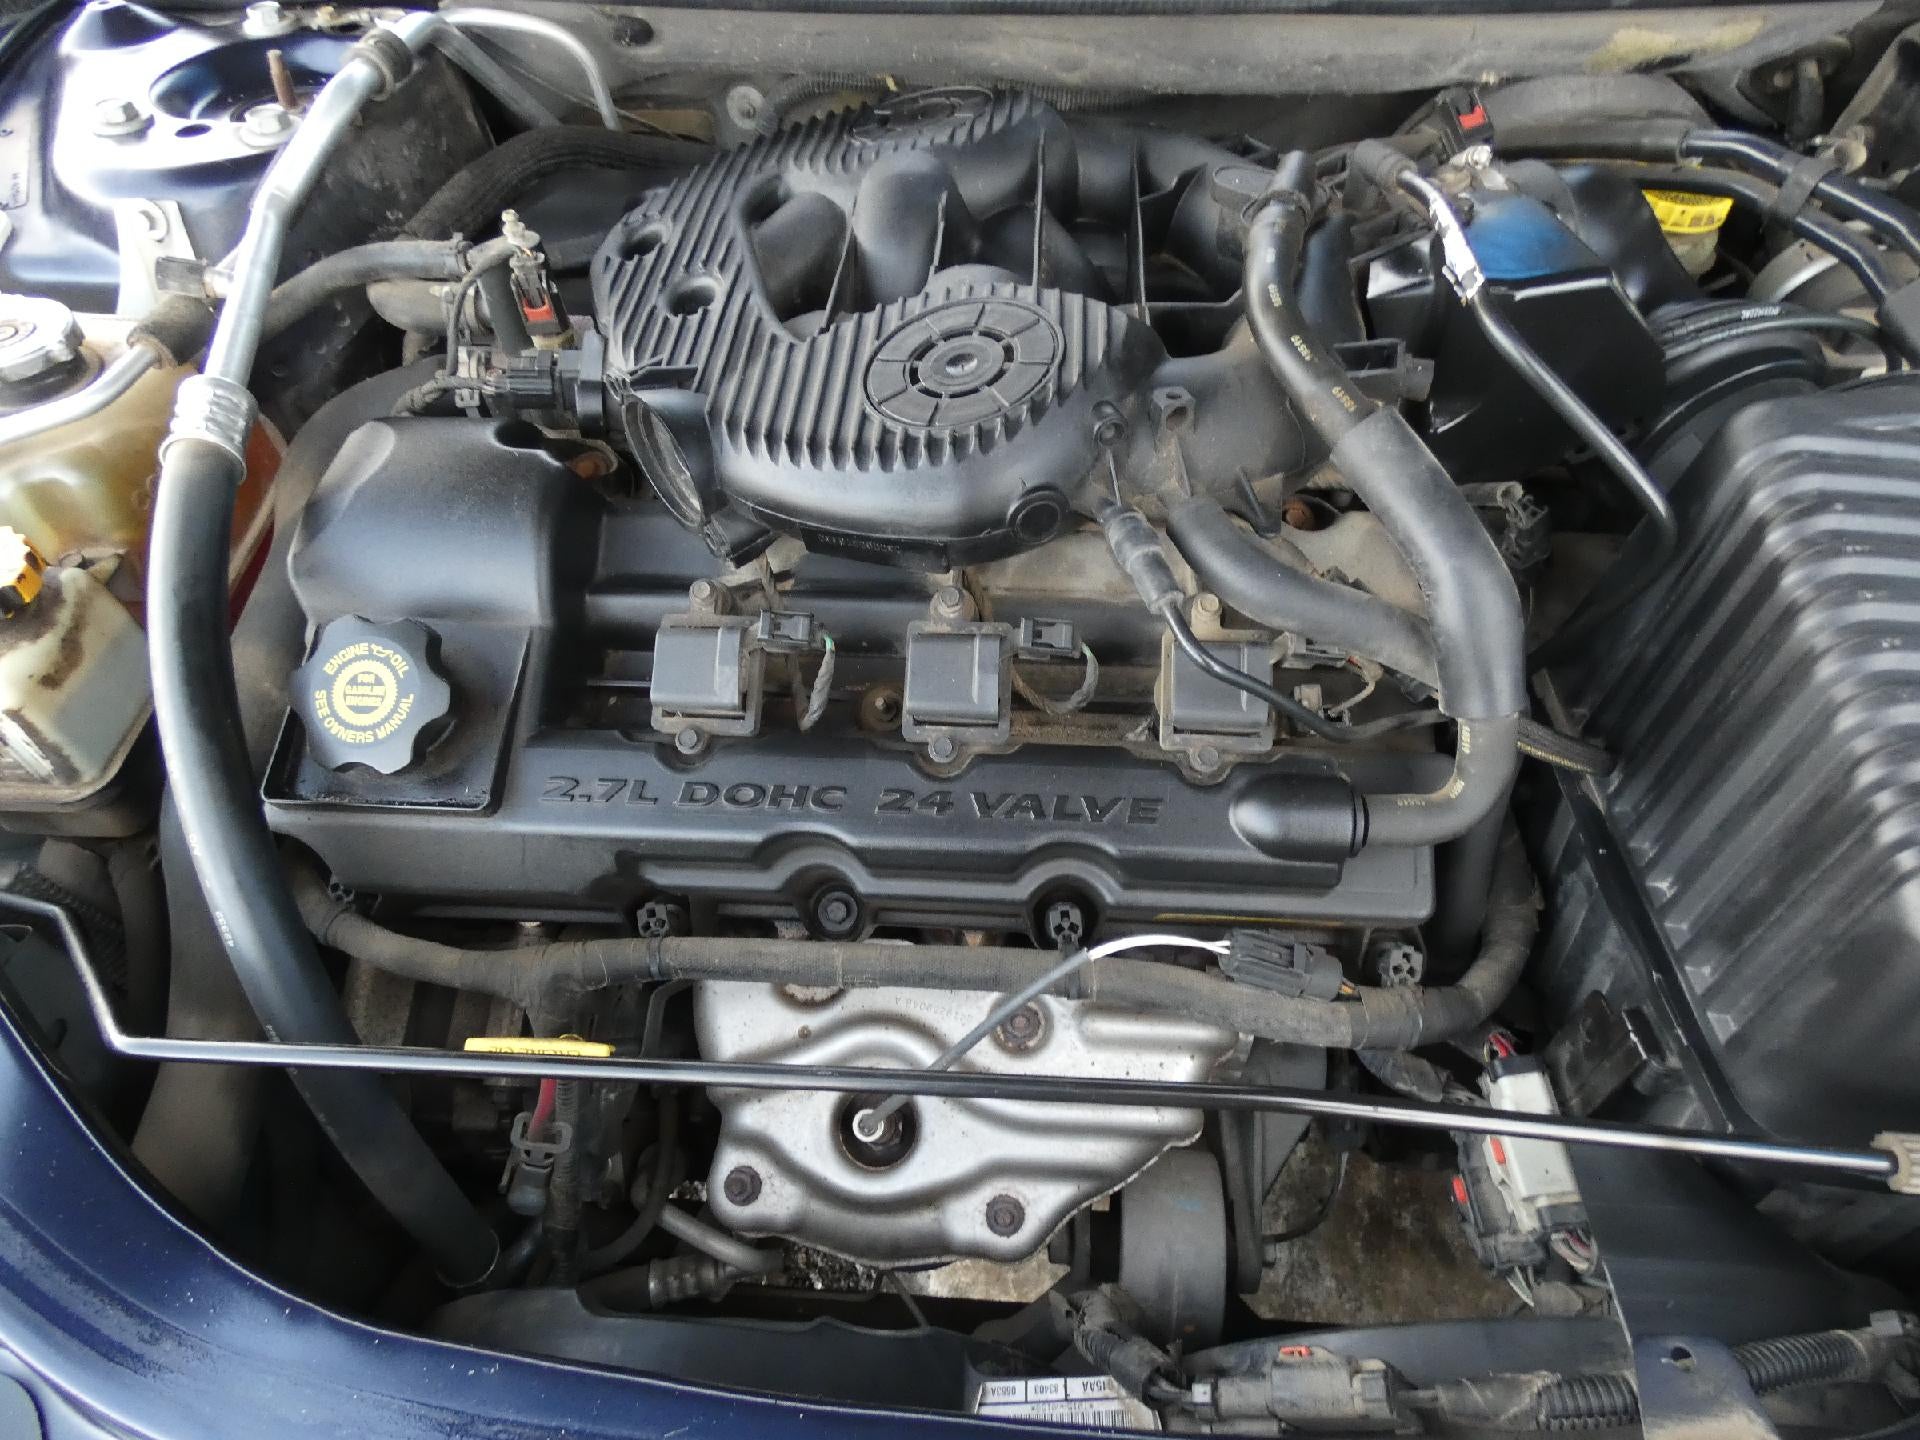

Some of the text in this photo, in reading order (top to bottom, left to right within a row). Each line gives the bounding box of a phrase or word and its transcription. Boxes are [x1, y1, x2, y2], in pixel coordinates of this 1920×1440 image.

[323, 642, 409, 679] ENGINE OIL
[314, 689, 415, 744] SEE OWNERS MANUAL
[541, 776, 1164, 825] 2.7L DOHC 24 VALVE
